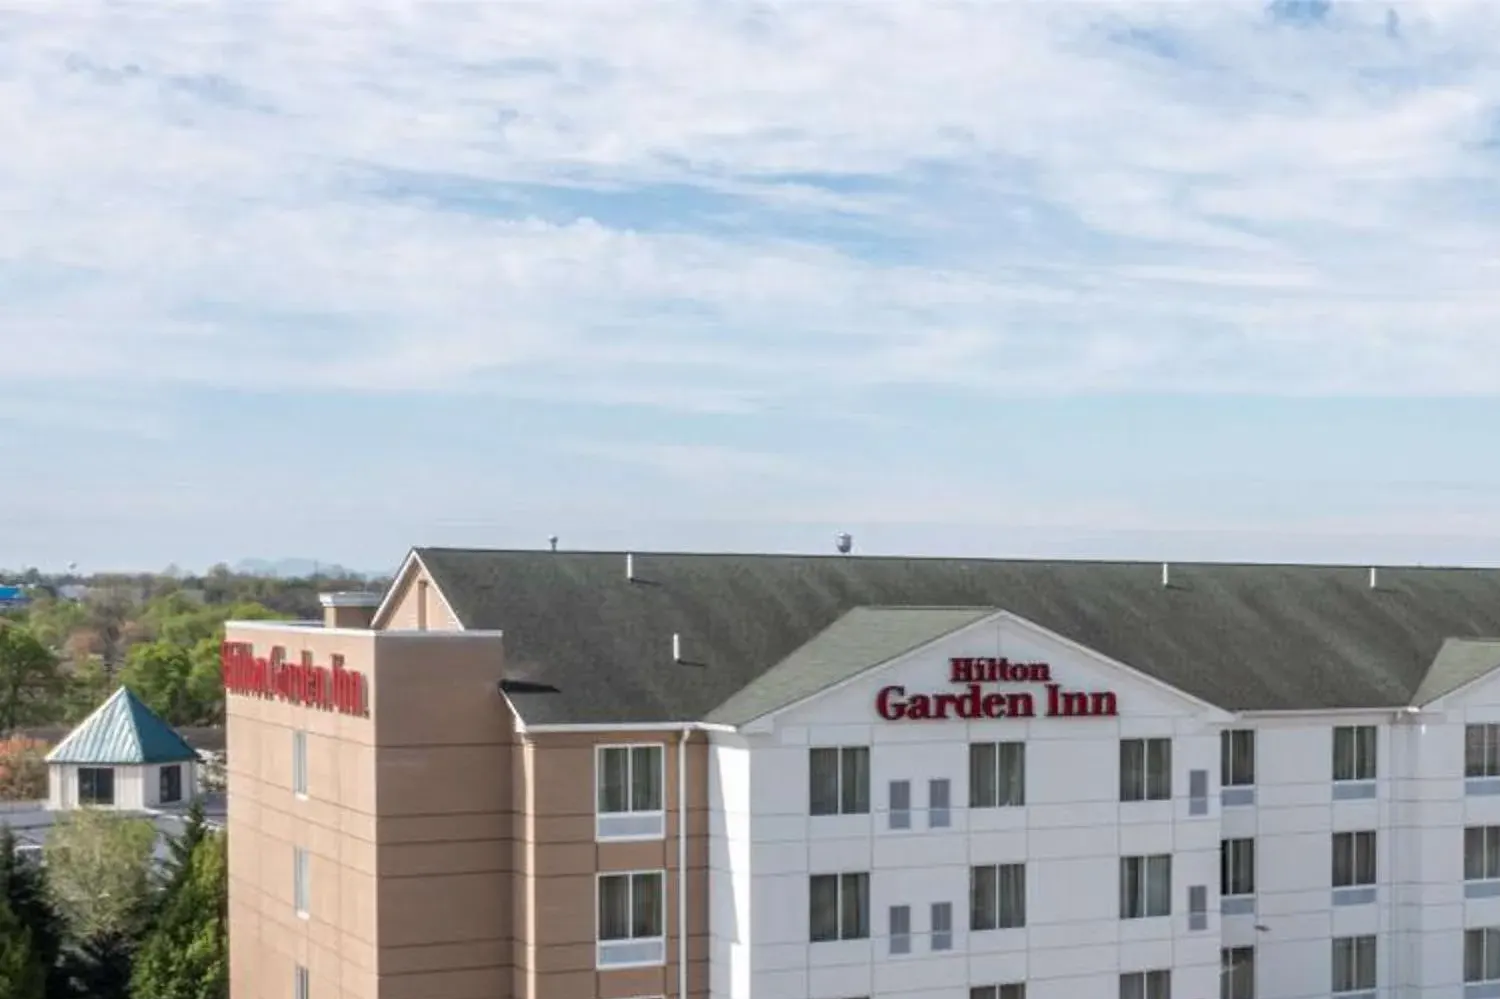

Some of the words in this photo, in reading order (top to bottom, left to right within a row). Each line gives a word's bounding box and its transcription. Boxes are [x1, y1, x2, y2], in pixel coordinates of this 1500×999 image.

[949, 657, 1052, 683] Hilton
[876, 684, 1036, 720] Garden
[1045, 683, 1120, 717] Inn
